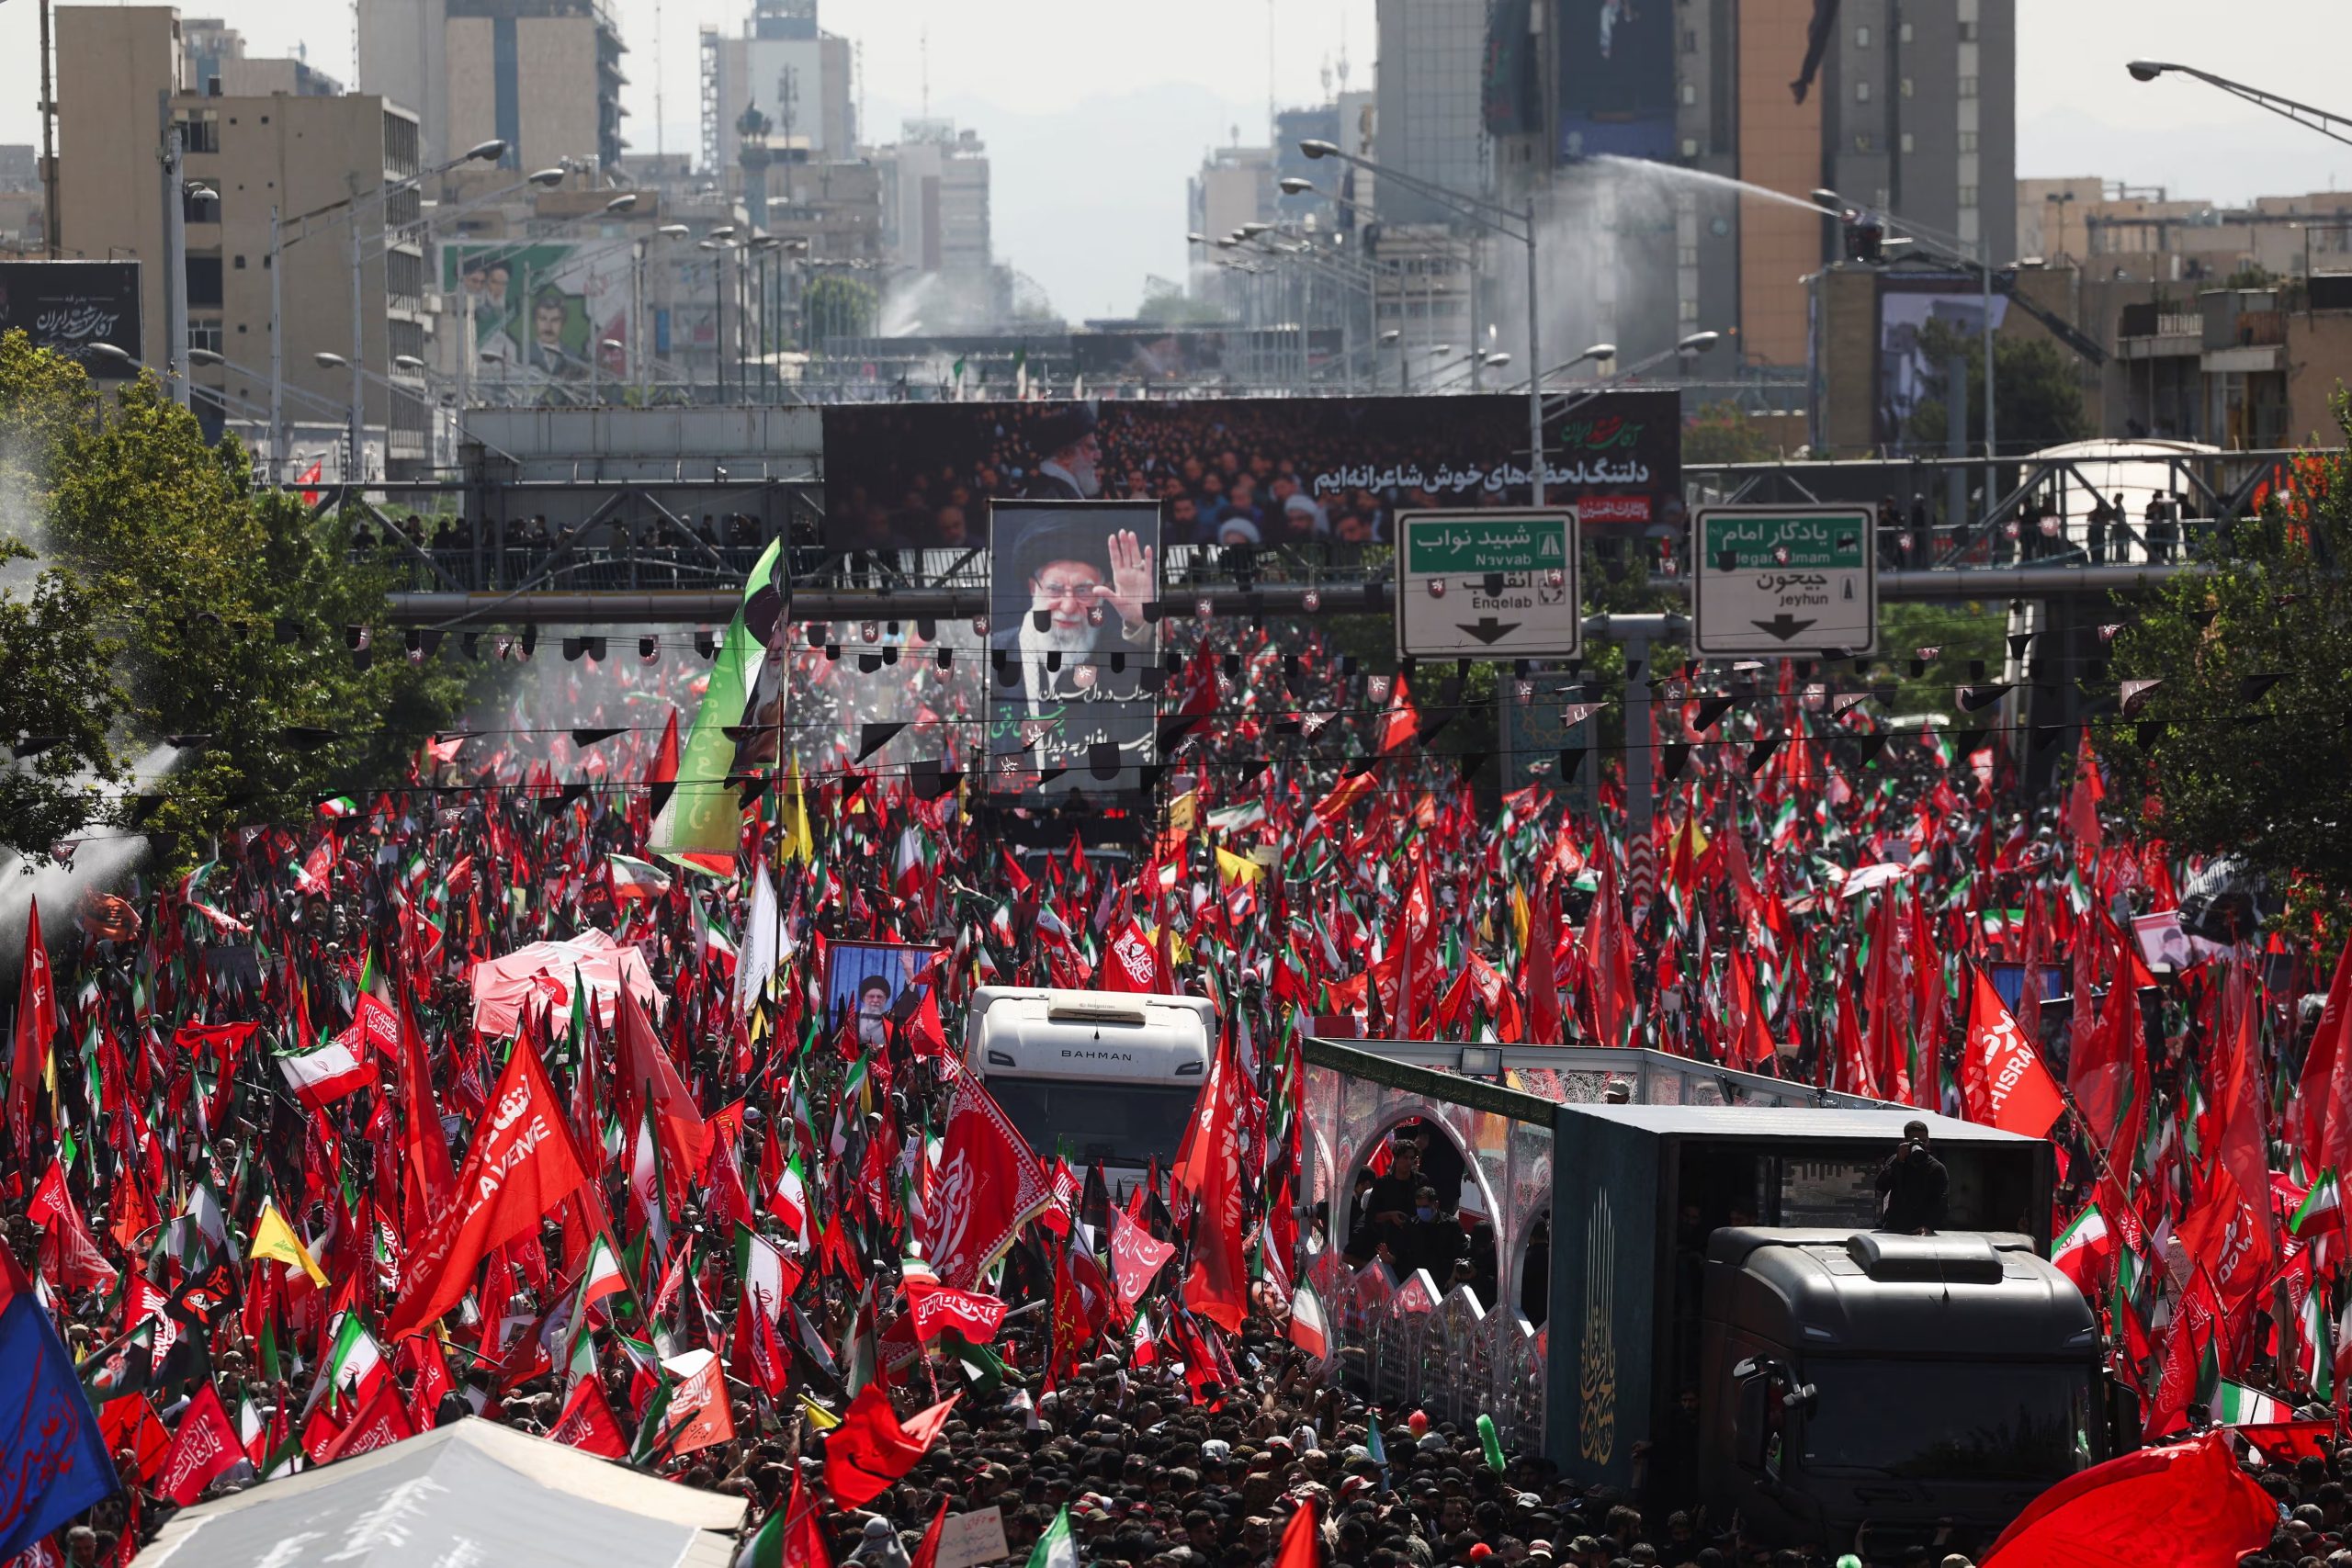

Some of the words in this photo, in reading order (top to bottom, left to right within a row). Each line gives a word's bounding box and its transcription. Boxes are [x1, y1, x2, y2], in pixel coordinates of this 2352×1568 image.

[1423, 461, 1484, 492] خوش
[1584, 457, 1649, 484] دلتنگ
[1417, 529, 1472, 555] نواب
[1477, 525, 1532, 549] شهید
[1723, 523, 1763, 551] امام
[1767, 521, 1828, 548] یادگار
[1463, 570, 1532, 595] انقب
[1757, 572, 1827, 594] جیحون
[1472, 596, 1532, 611] Enqelab
[1061, 1050, 1132, 1061] BAHMAN
[478, 1114, 551, 1201] AVENE
[2218, 1235, 2254, 1285] DOW
